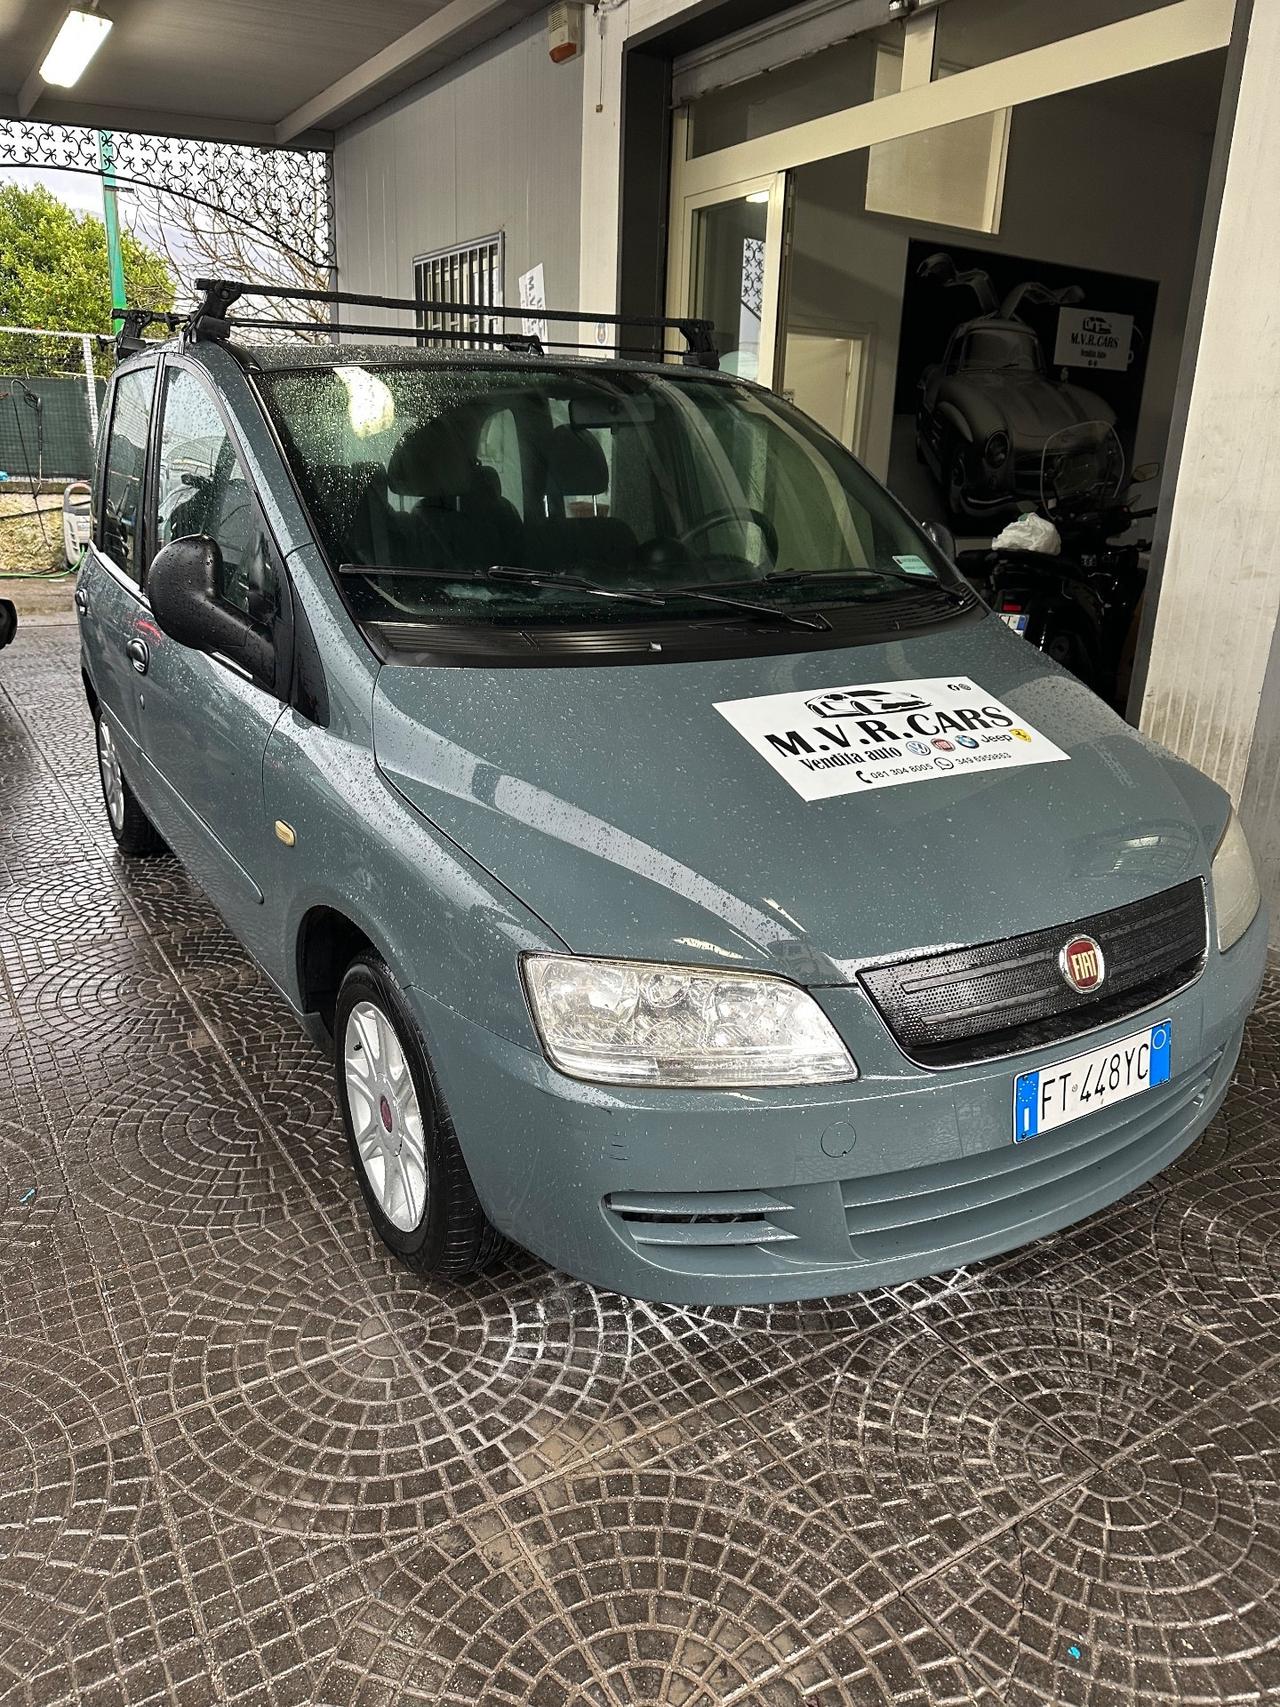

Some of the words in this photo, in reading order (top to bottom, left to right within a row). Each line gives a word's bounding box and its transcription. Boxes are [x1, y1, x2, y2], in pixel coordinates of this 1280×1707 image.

[764, 706, 1013, 757] M.V.R.CARS
[799, 752, 866, 771] Vendita
[864, 746, 902, 761] auto
[981, 734, 1013, 743] Jeep
[870, 770, 889, 779] 081
[890, 767, 909, 776] 304
[1070, 950, 1097, 981] FIAT
[1042, 1073, 1071, 1120] FT
[1079, 1043, 1149, 1102] 448YC
